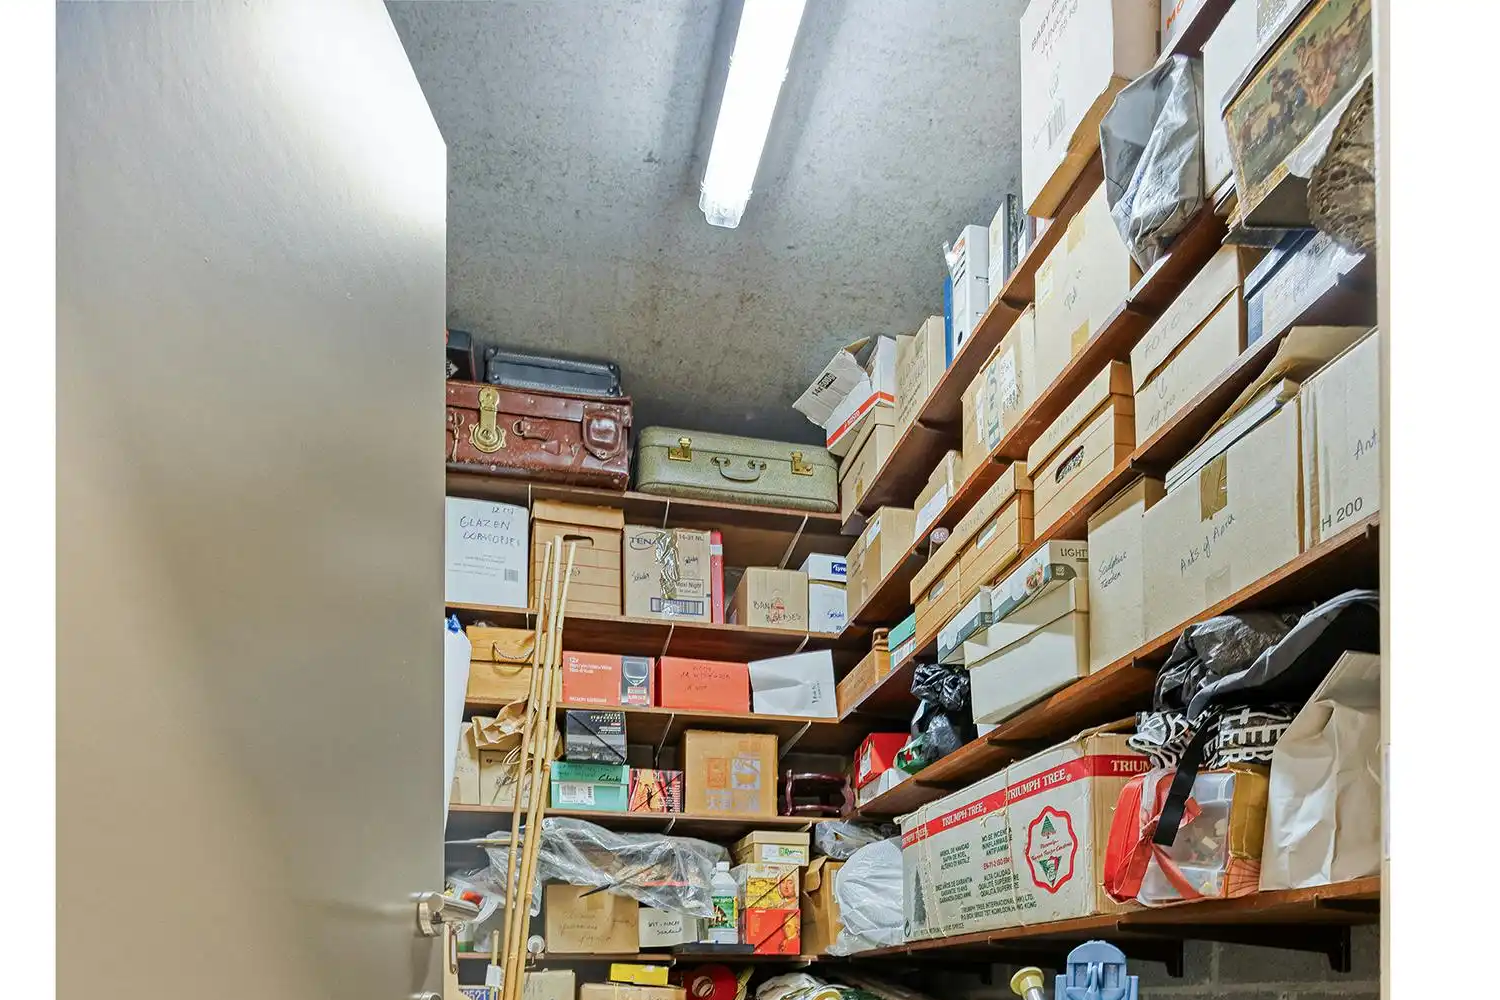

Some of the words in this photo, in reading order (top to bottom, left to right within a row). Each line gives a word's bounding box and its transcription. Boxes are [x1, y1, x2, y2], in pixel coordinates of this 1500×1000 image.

[1321, 514, 1332, 532] H
[1336, 496, 1364, 523] 200
[1110, 759, 1151, 772] TRIUM
[1006, 776, 1041, 801] TRIUMPH
[1041, 767, 1066, 787] TREE
[941, 808, 967, 828] TRIUMPH
[967, 802, 984, 818] TREE
